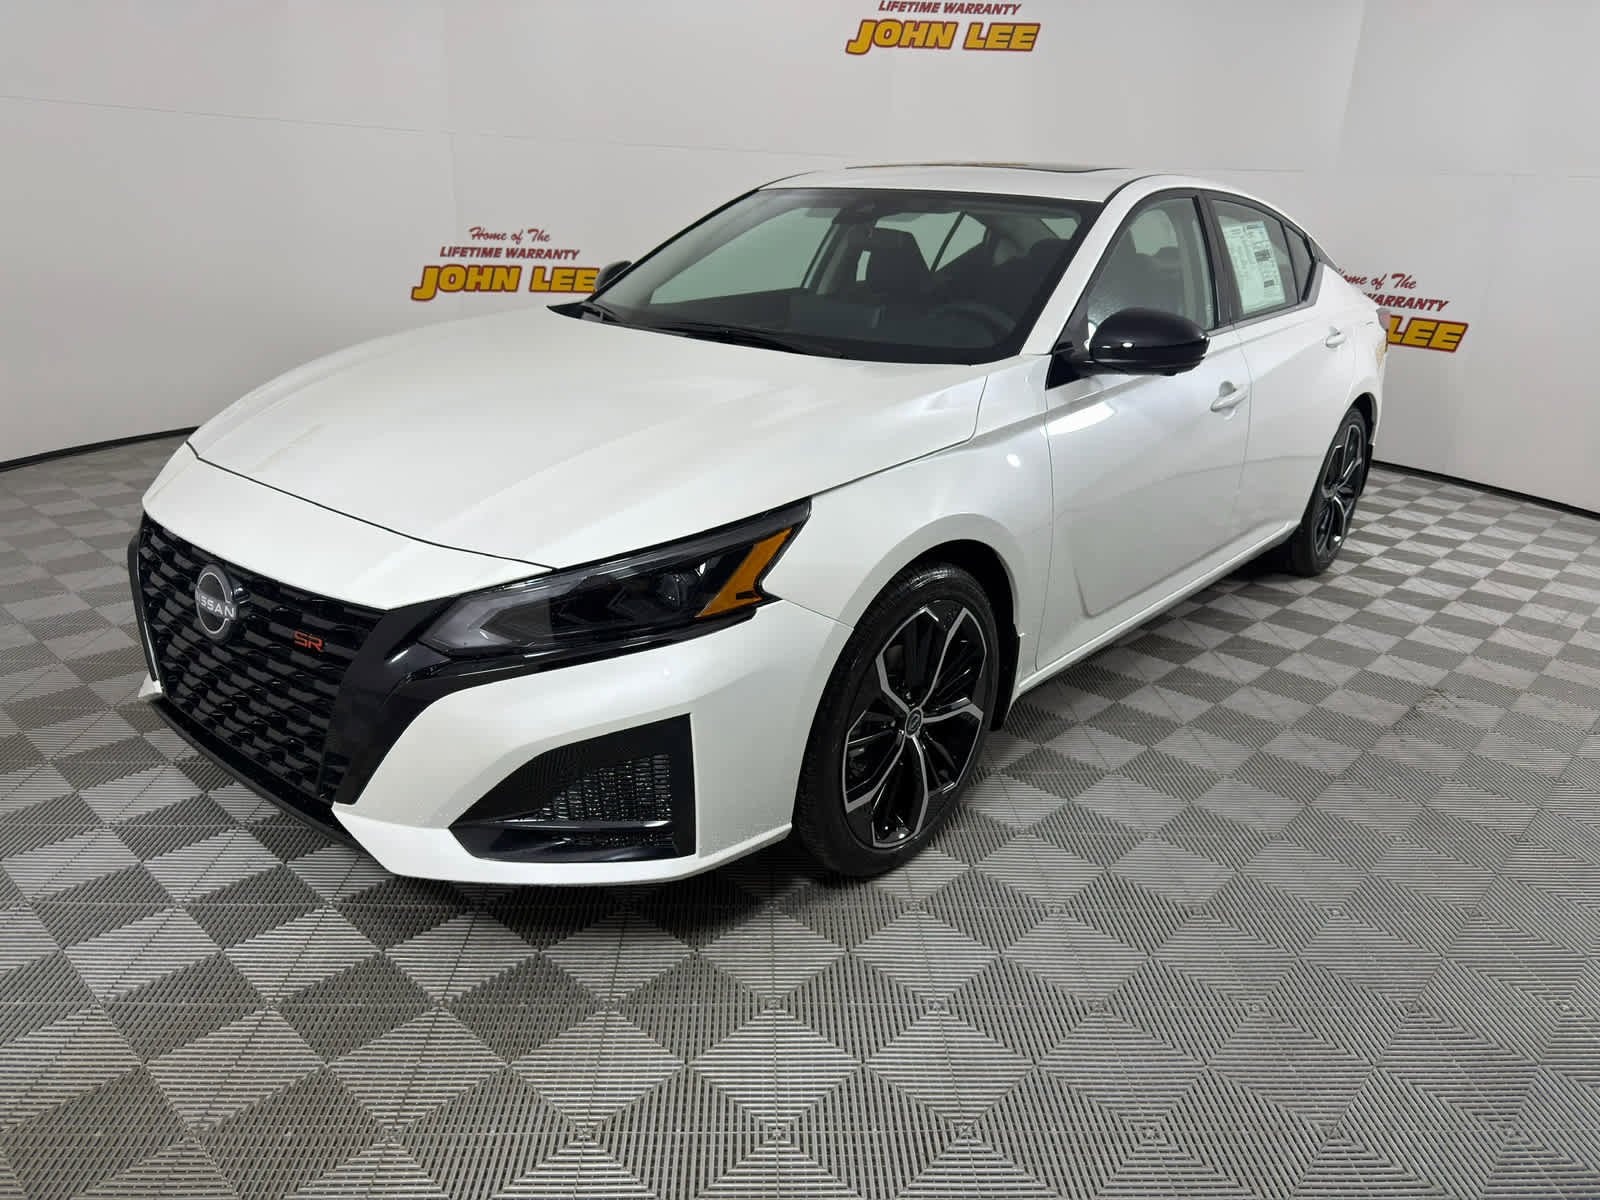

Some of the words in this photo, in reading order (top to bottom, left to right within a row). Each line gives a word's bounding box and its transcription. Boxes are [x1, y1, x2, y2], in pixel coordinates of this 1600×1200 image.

[878, 0, 940, 13] LIFETIME
[943, 1, 1021, 15] WARRANTY
[845, 18, 959, 55] JOHN
[962, 22, 1041, 52] LEE
[468, 226, 507, 241] Home
[511, 229, 524, 245] of
[527, 228, 551, 242] The
[440, 246, 502, 258] LIFETIME
[505, 247, 580, 260] WARRANTY
[411, 263, 523, 302] JOHN
[528, 266, 600, 294] LEE
[1370, 273, 1388, 291] of
[1391, 273, 1416, 289] The
[1387, 314, 1469, 353] LEE
[294, 631, 324, 653] SR
